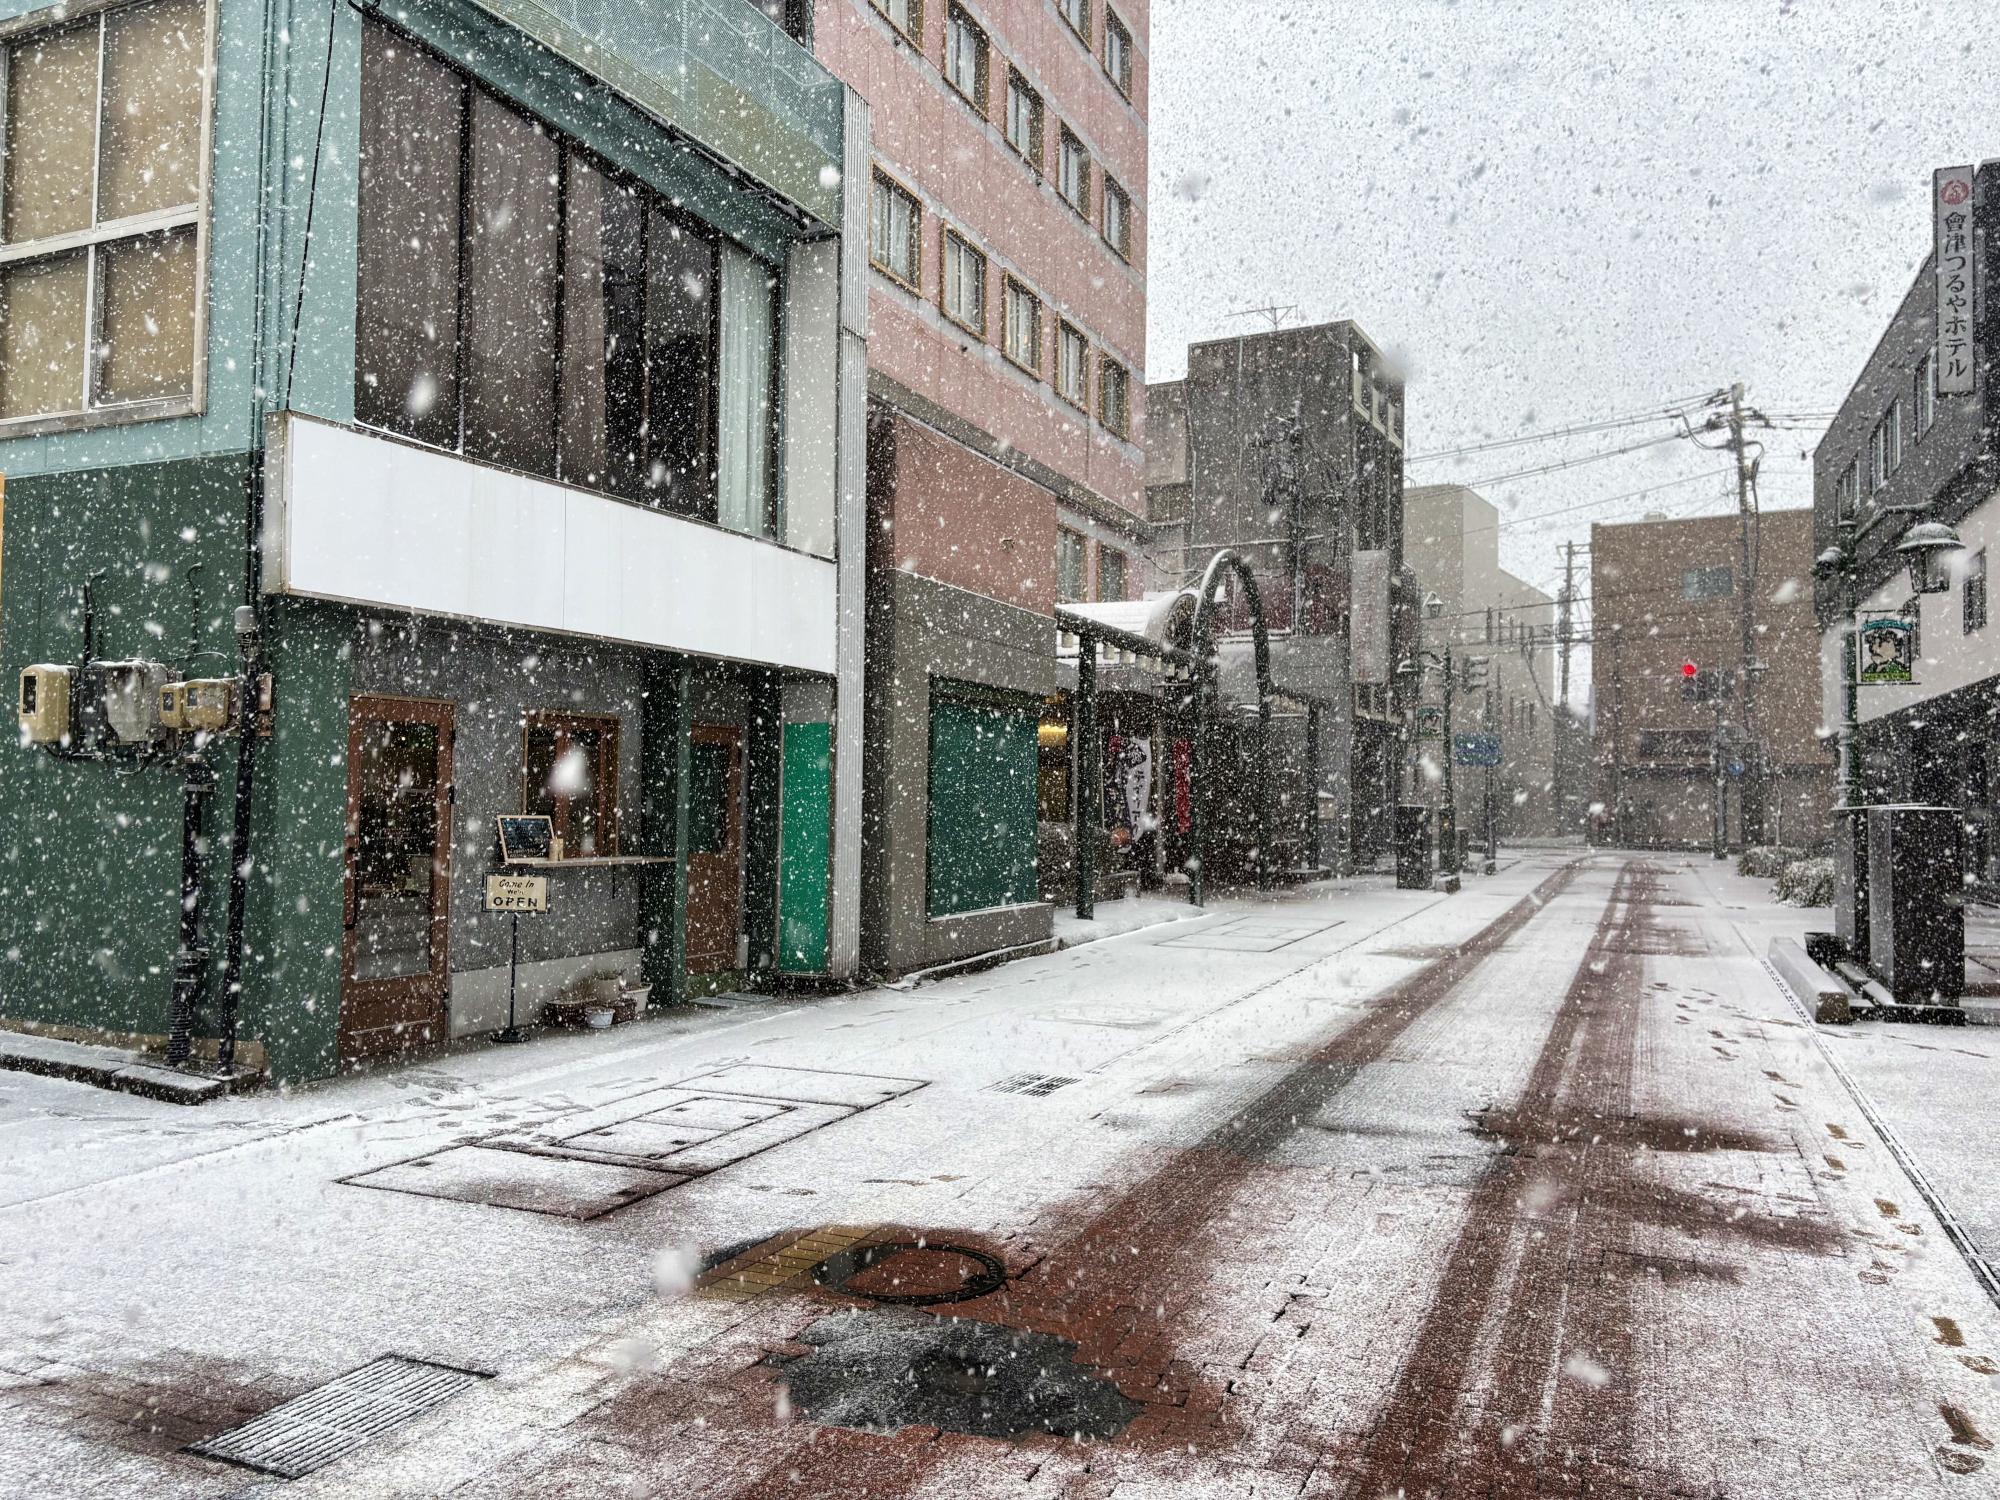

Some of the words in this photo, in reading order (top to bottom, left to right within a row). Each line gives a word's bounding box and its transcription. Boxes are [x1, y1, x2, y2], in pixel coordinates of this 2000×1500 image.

[1944, 211, 1967, 378] 會津つるやホテル
[499, 879, 523, 888] Come
[525, 880, 535, 888] In
[493, 896, 538, 907] OPEN
